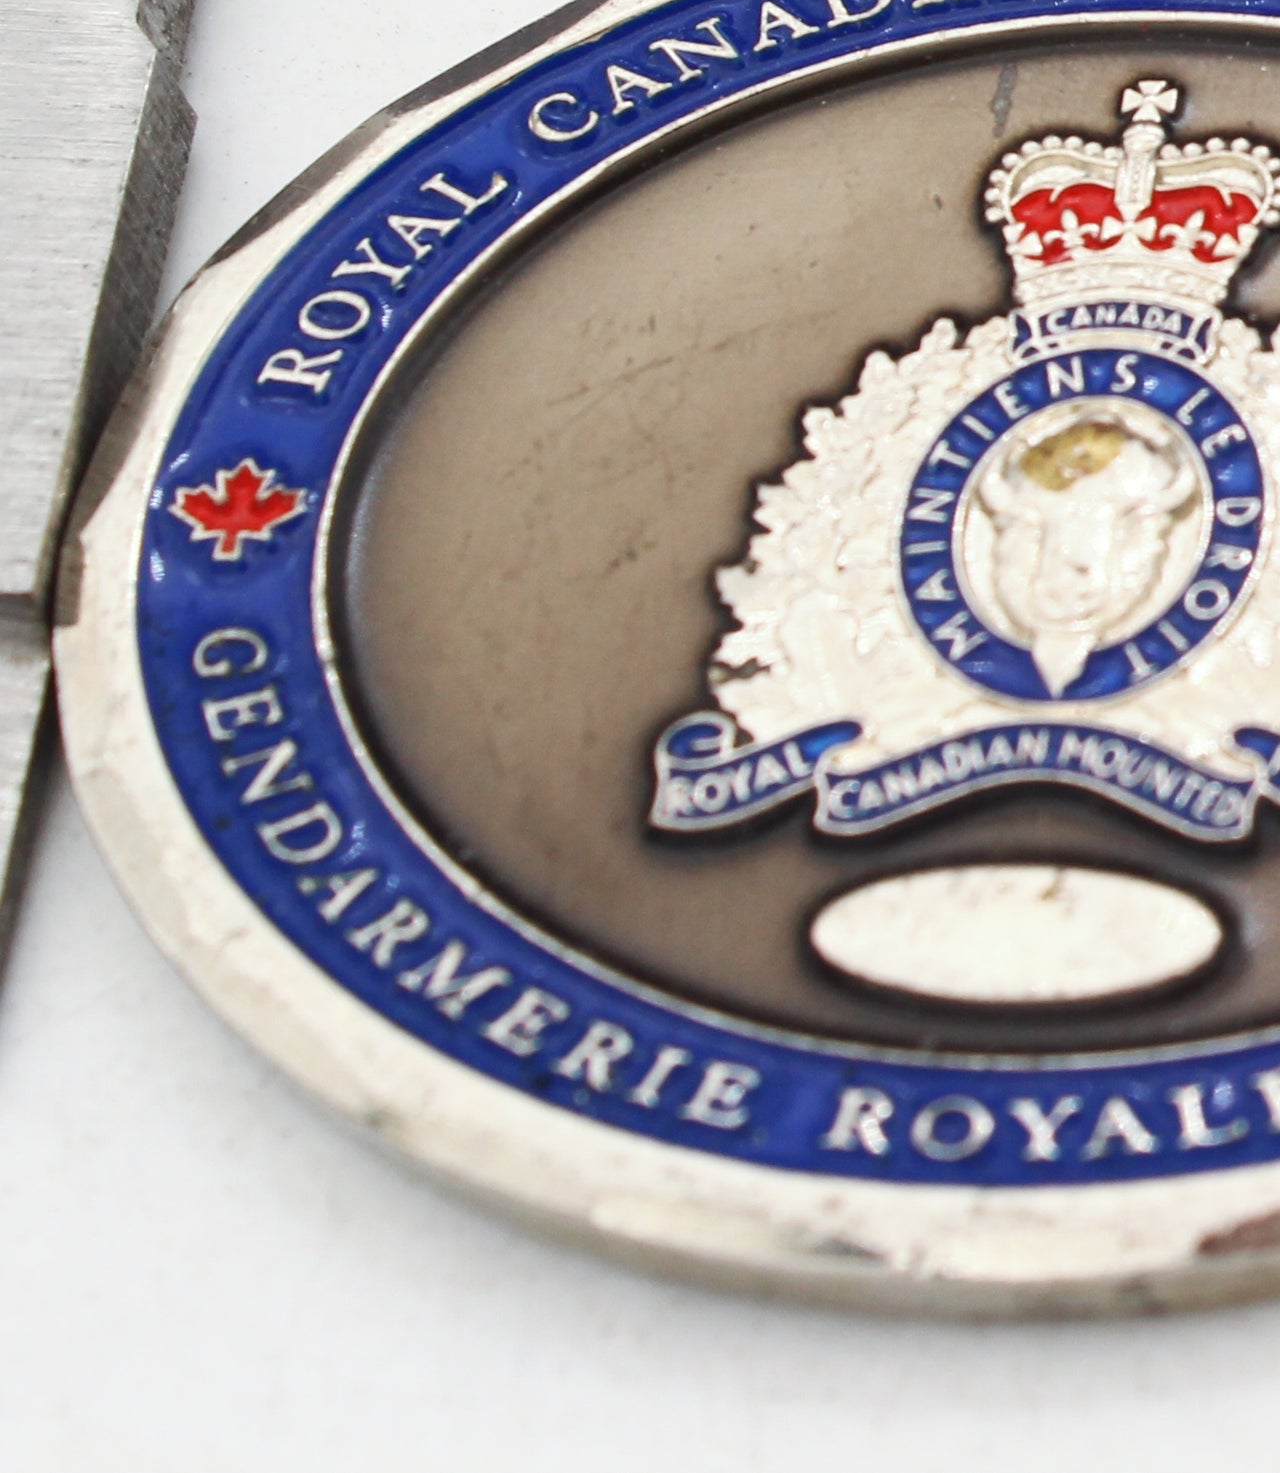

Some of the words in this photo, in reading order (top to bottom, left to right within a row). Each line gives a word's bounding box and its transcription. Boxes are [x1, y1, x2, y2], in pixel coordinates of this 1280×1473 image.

[258, 170, 508, 393] ROYAL
[1045, 300, 1183, 334] CANADA
[905, 354, 1140, 661] MAINTIENS
[1175, 387, 1247, 460] LE
[1122, 495, 1263, 684] DROIT
[668, 740, 815, 818] ROYAL
[828, 726, 1048, 821] CANADIAN
[1056, 729, 1248, 828] MOUNTED
[192, 625, 762, 1130] GENDARMERIE
